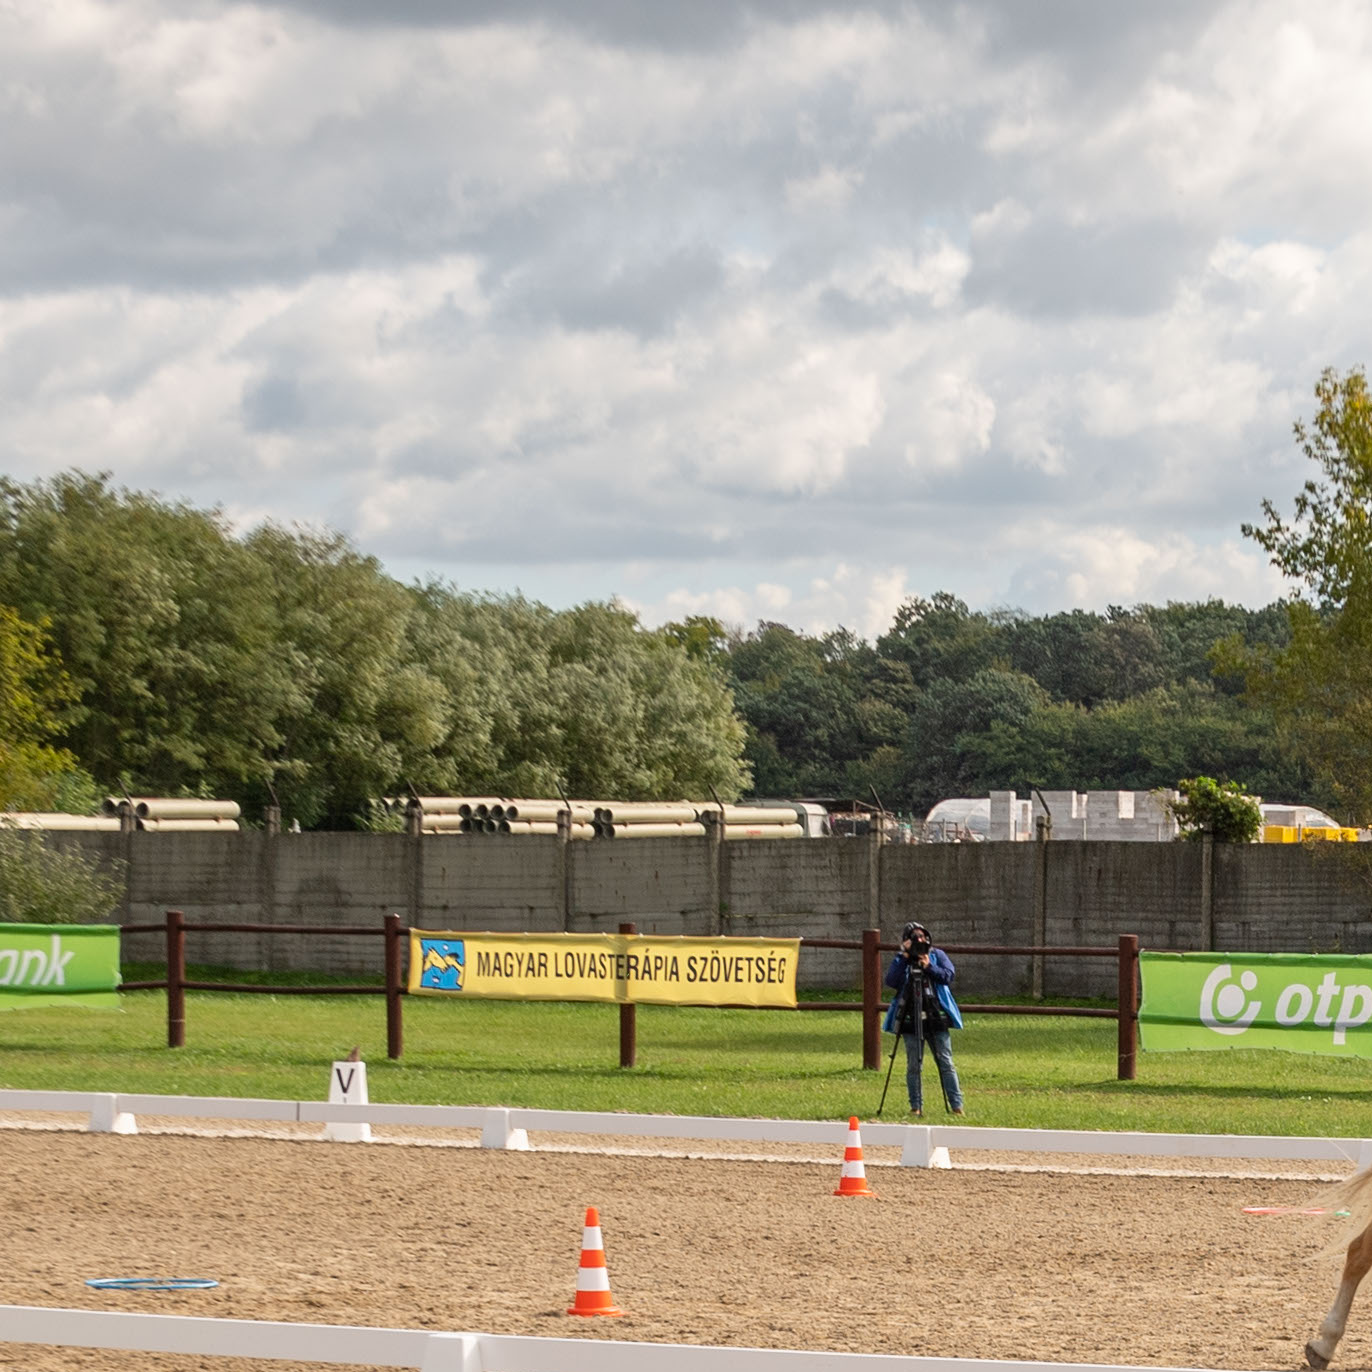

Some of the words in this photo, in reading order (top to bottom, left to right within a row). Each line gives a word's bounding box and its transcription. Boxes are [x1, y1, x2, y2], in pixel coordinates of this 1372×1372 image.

[476, 951, 548, 978] MAGYAR
[554, 948, 680, 982] LOVASTERÁPIA
[687, 950, 786, 984] SZÖVETSÉG
[336, 1068, 355, 1094] V
